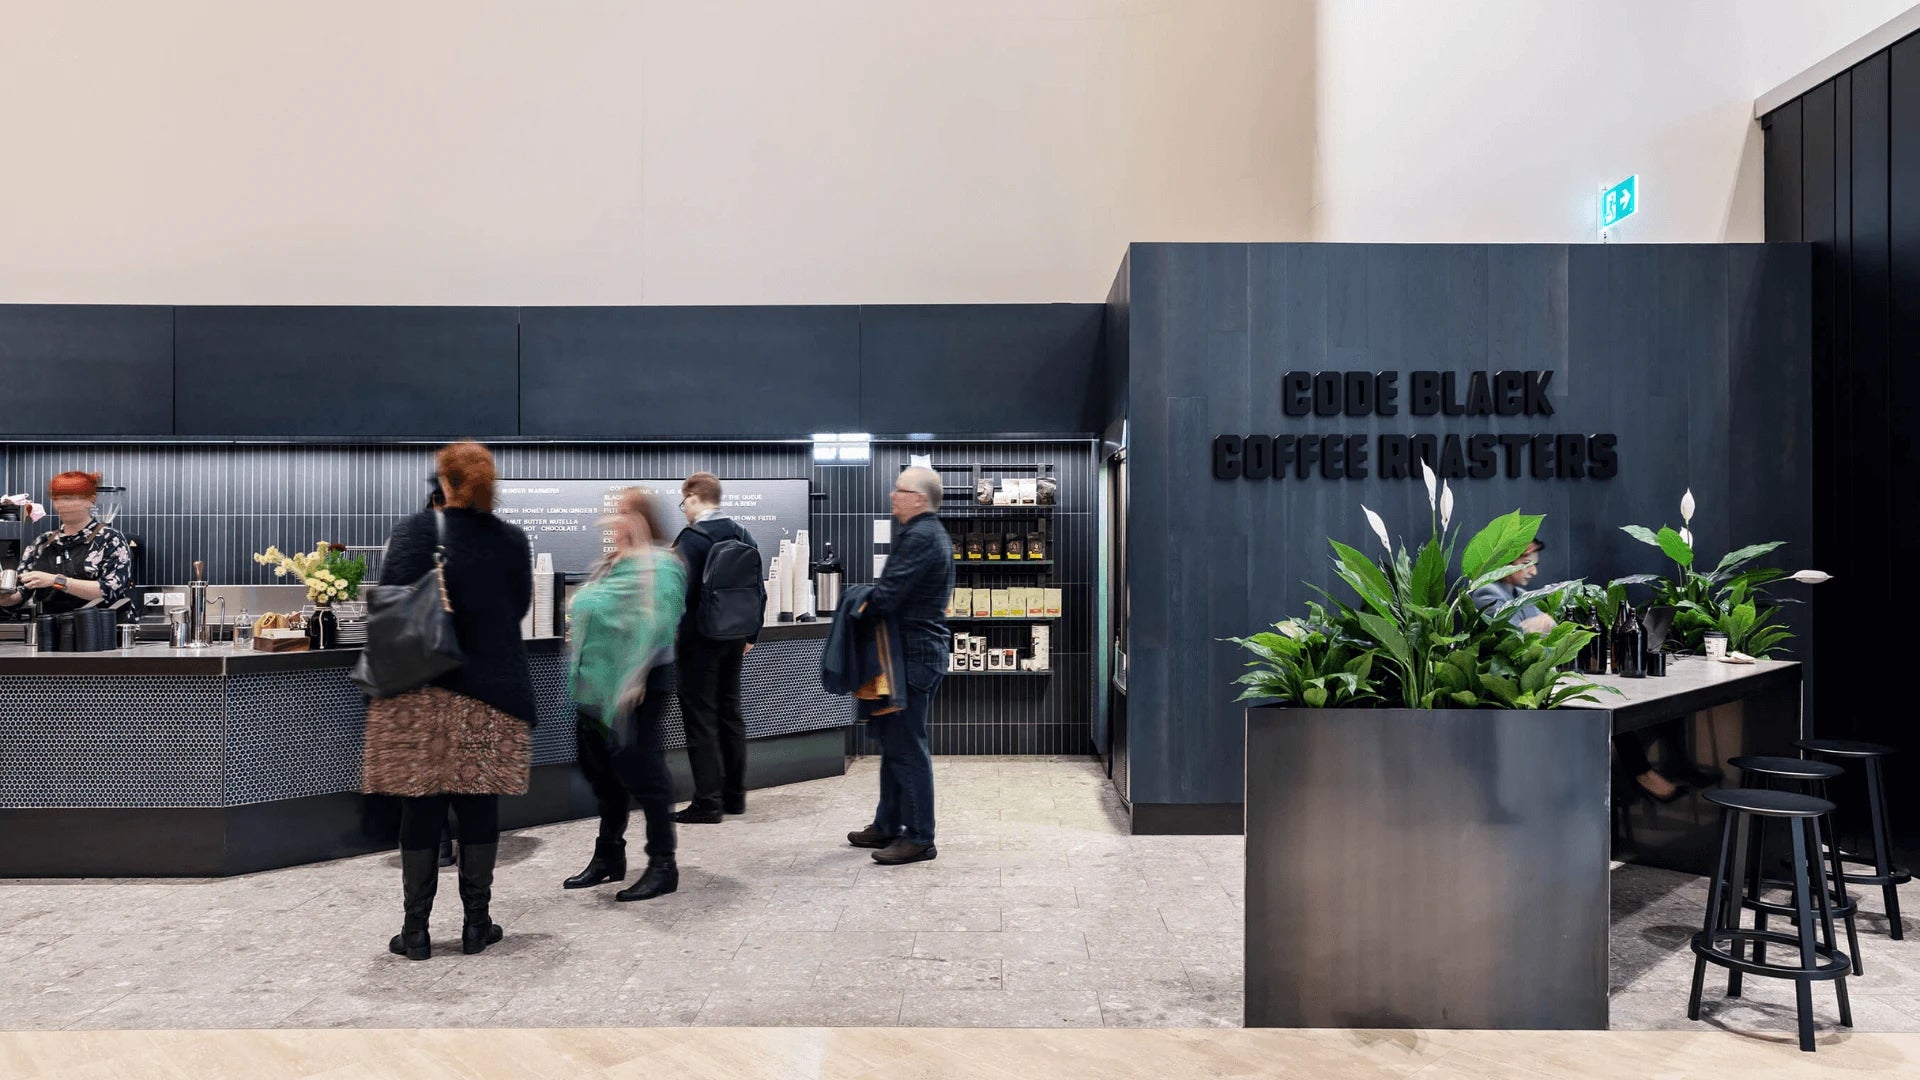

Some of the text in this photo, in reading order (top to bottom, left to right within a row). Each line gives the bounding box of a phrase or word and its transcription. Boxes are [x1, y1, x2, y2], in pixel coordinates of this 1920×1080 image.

[1283, 370, 1555, 416] CODE BLACK
[1213, 433, 1619, 480] COFFEE ROASTERS
